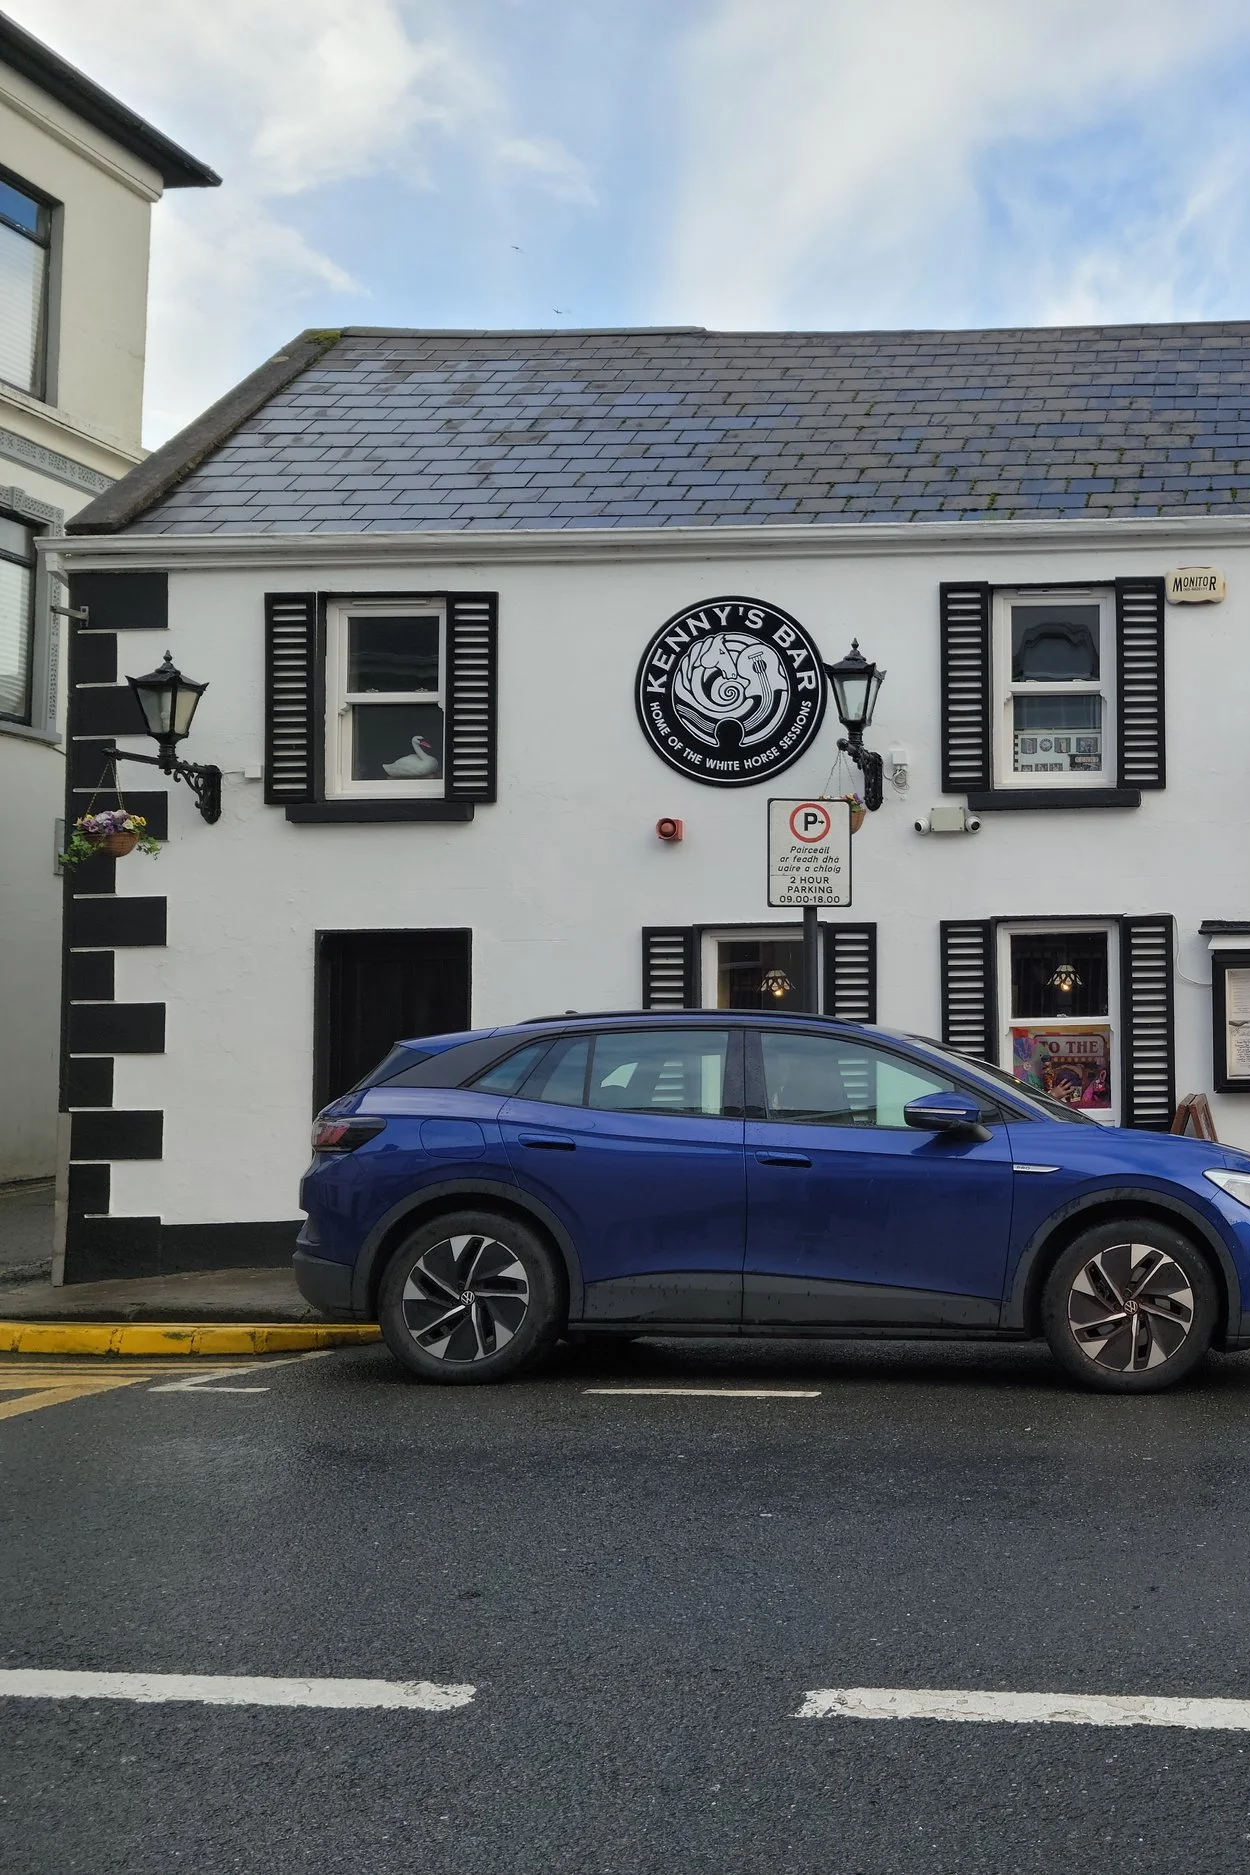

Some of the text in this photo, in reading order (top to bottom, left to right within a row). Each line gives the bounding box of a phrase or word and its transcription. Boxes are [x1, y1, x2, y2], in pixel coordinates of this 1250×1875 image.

[1172, 576, 1217, 592] MONITOR
[646, 606, 816, 694] KENNY'S BAR
[650, 700, 812, 771] HOME OF THE WHITE HORSE SESSIONS
[804, 812, 818, 831] P
[793, 855, 819, 863] feadh
[777, 864, 801, 873] uaire
[813, 864, 842, 874] chloig
[789, 876, 830, 884] 2 HOUR
[787, 886, 834, 894] PARKING
[1066, 1041, 1099, 1054] THE
